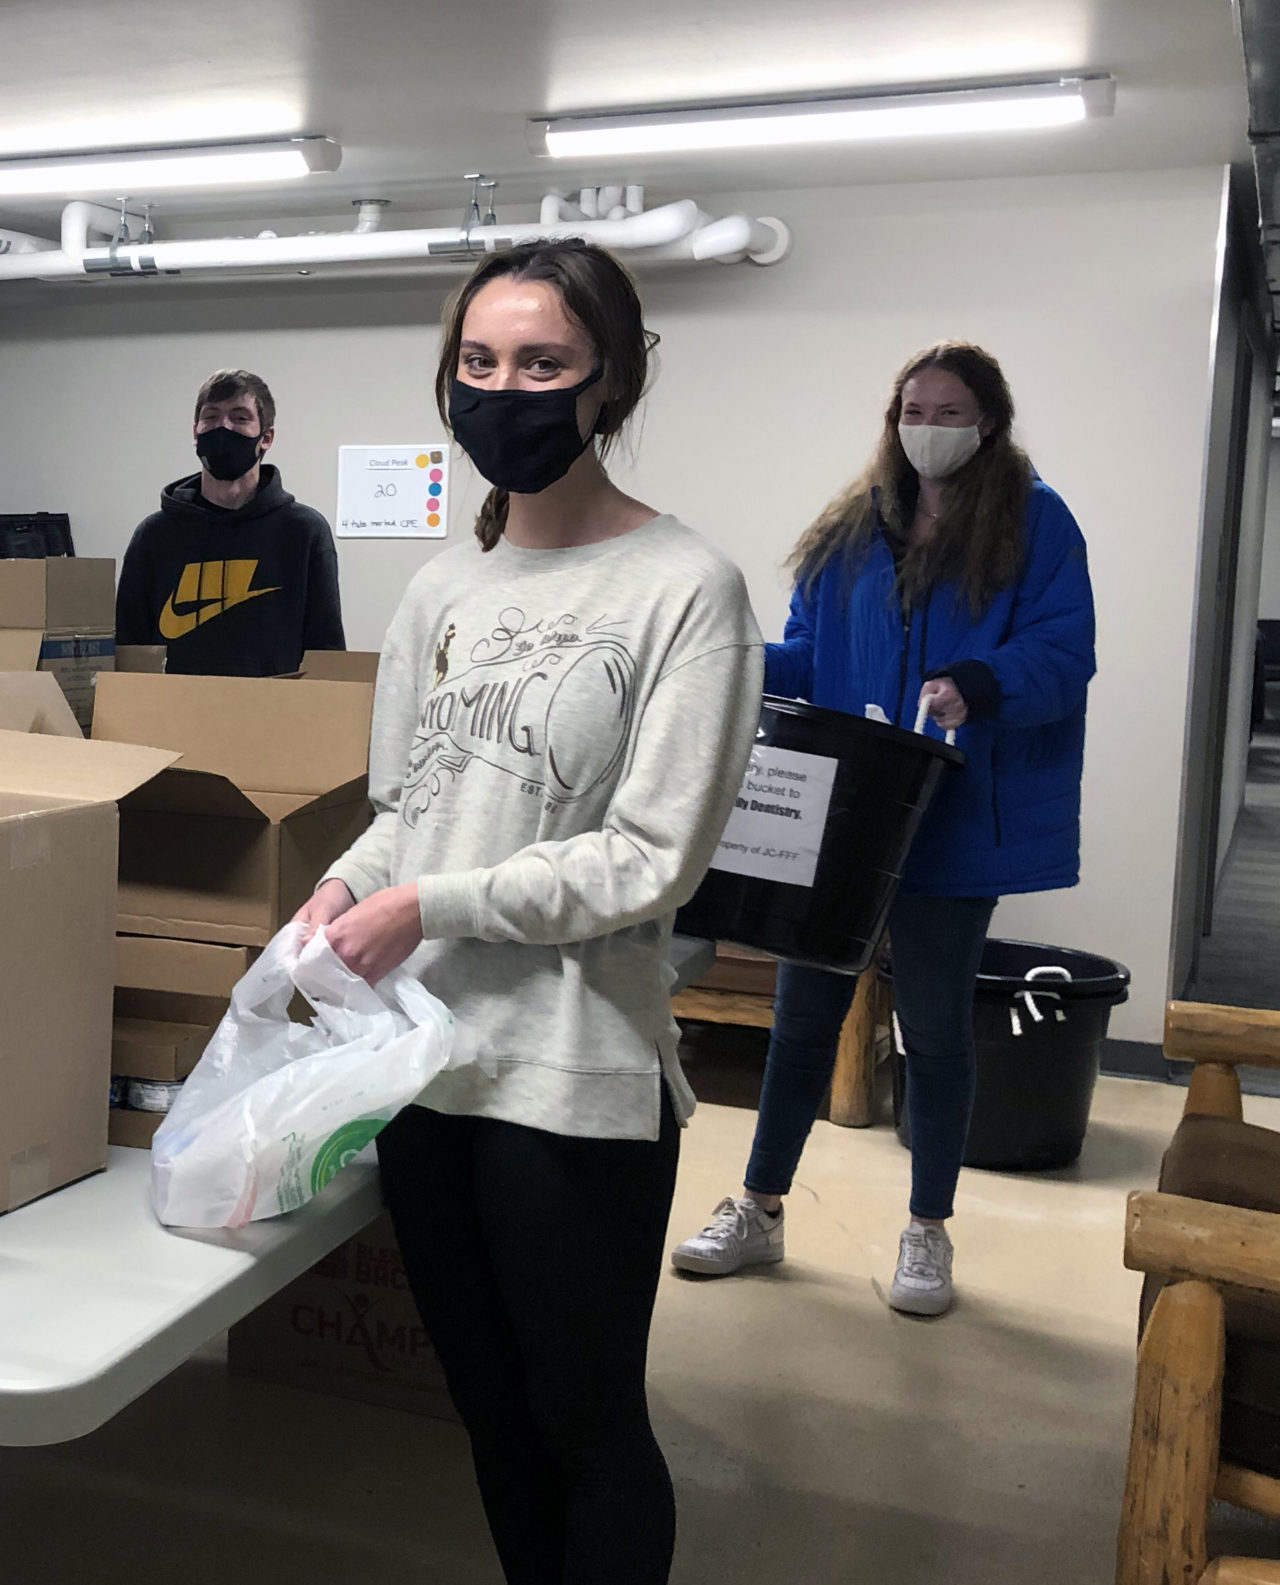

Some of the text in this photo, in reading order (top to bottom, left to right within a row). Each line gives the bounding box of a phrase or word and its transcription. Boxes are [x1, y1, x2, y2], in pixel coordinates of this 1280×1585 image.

[374, 483, 397, 498] 20
[767, 766, 807, 782] please
[747, 780, 801, 799] bucket to
